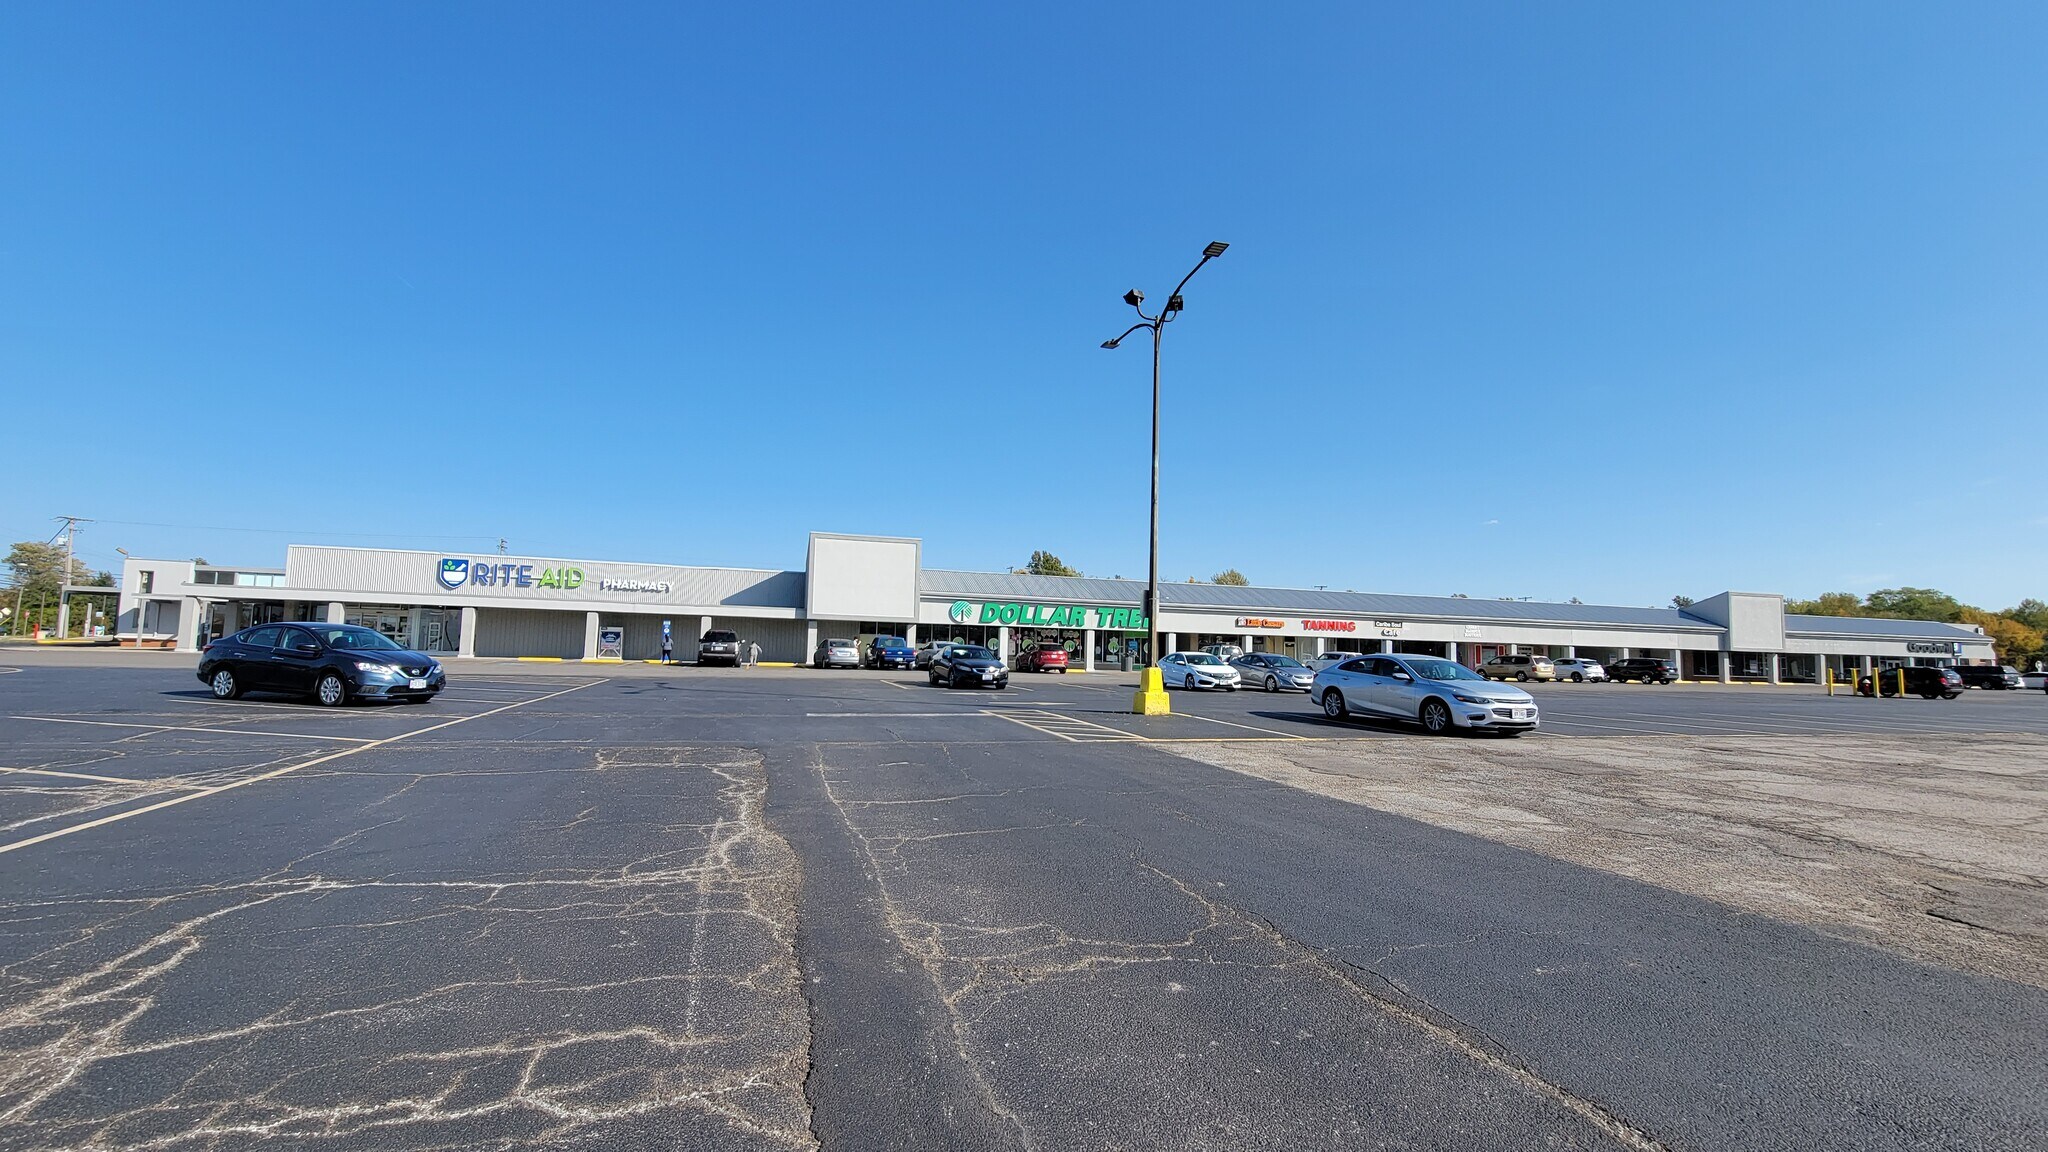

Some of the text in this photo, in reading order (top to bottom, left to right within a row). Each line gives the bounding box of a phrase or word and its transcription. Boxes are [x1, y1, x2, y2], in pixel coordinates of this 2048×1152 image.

[473, 563, 586, 588] RITE AID
[602, 579, 674, 593] PHARMACY
[980, 602, 1149, 629] DOLLAR TRE
[1302, 620, 1356, 632] TANNING
[1907, 641, 1953, 654] Goodwill
